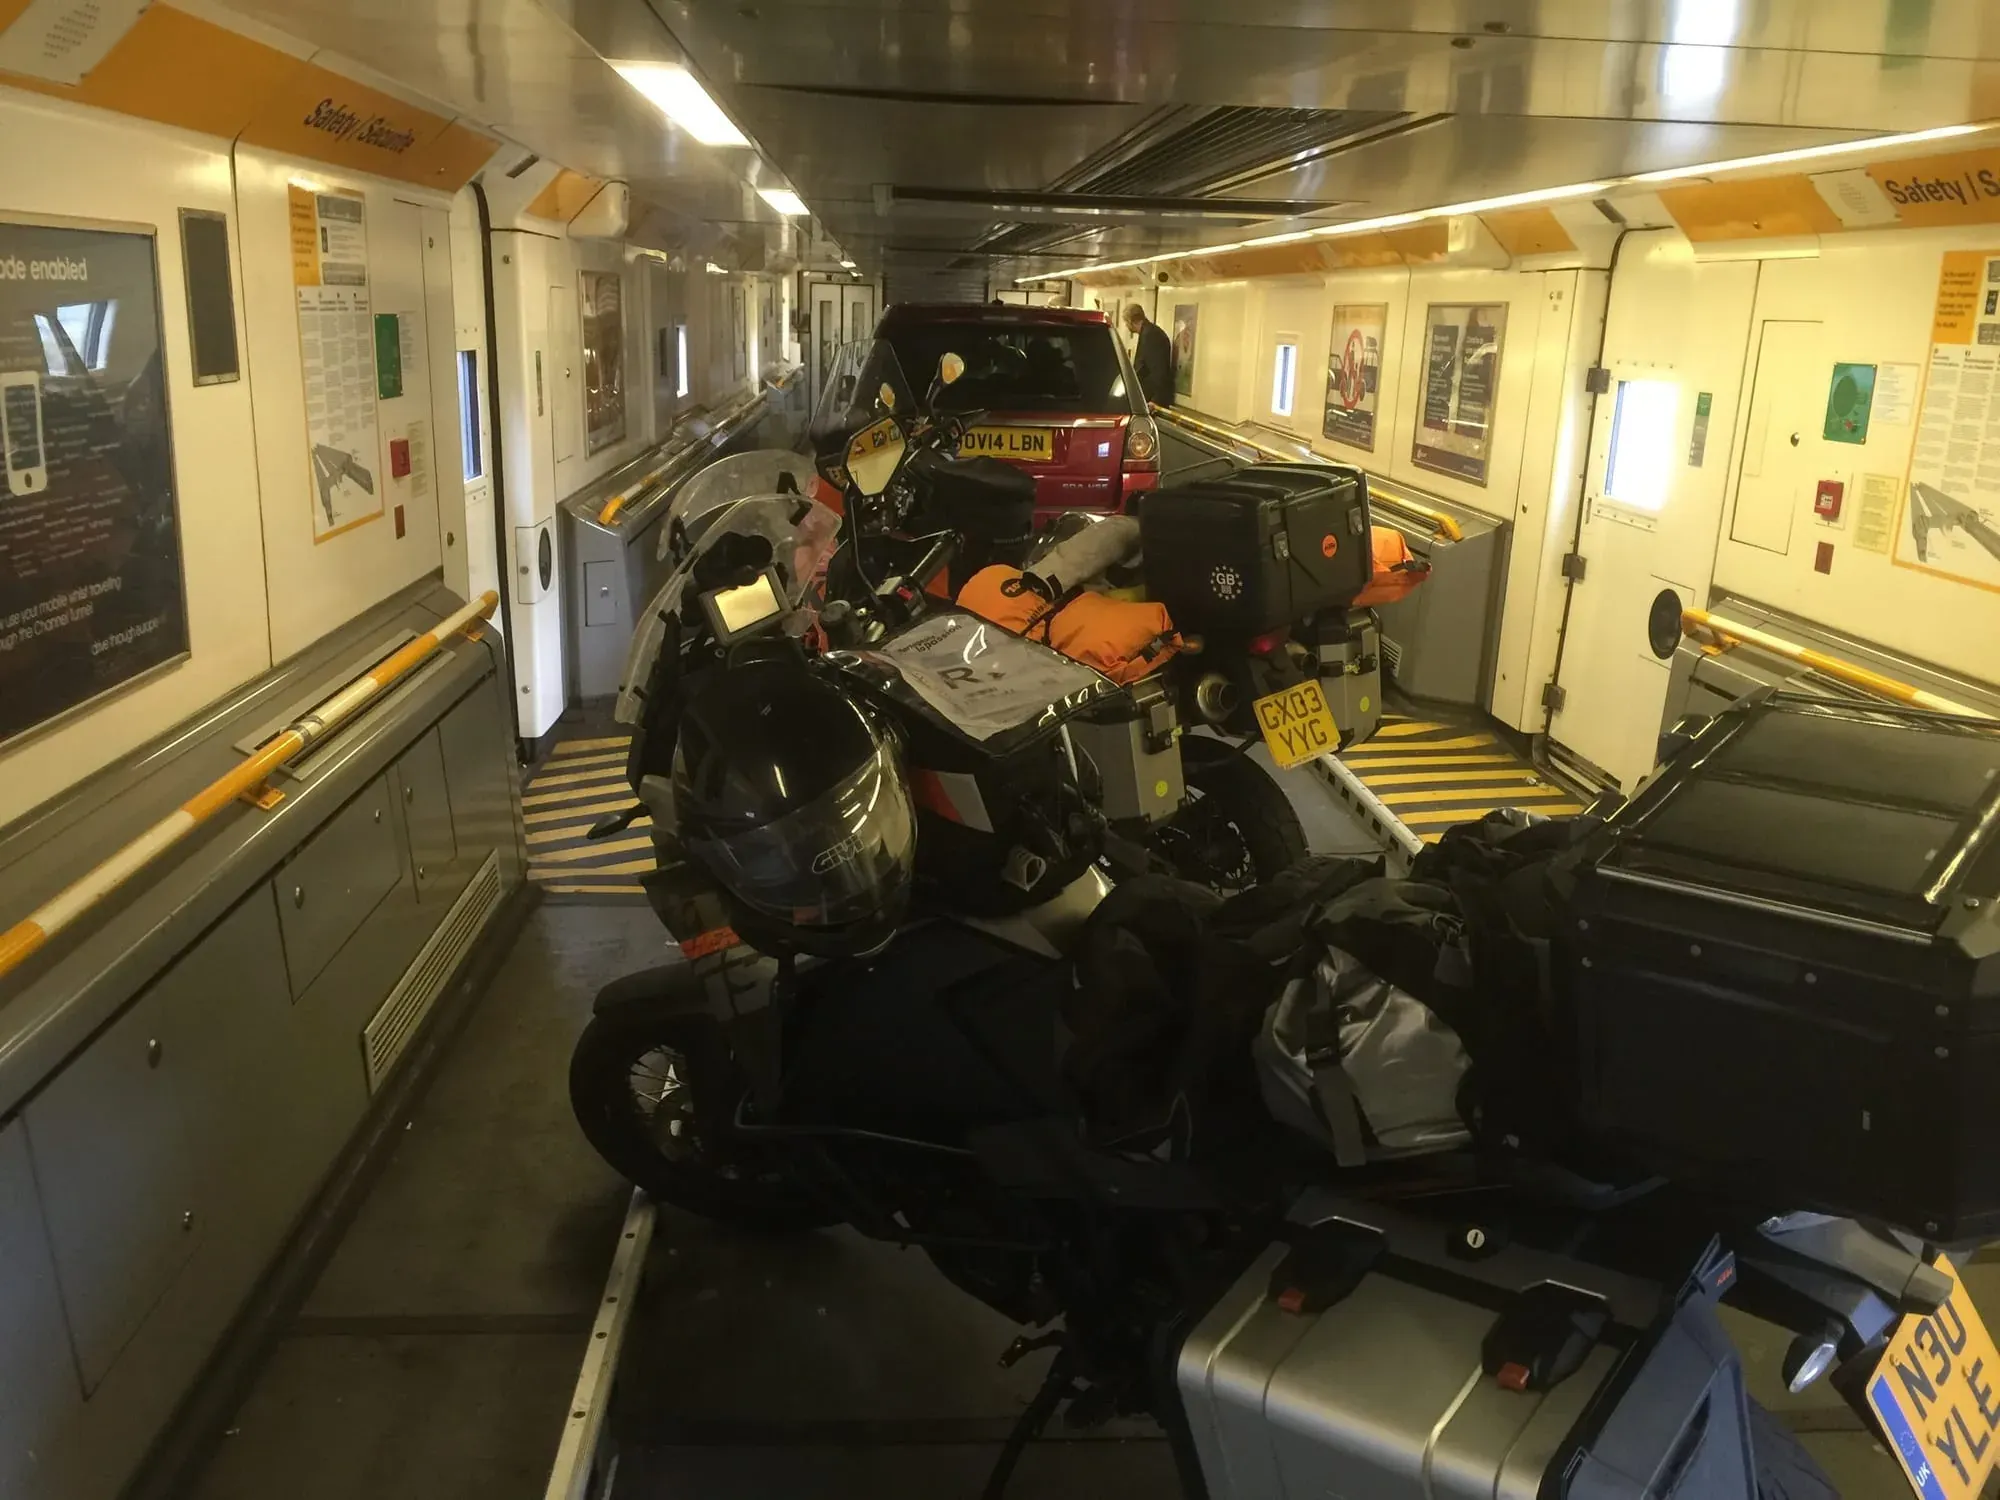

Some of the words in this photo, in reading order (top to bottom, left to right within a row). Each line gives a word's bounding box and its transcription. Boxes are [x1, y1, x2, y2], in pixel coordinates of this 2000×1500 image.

[303, 97, 361, 142] Safety
[1885, 175, 1968, 206] Safety
[964, 433, 1005, 450] OV14
[1009, 434, 1045, 452] LBN
[1216, 572, 1235, 586] GB
[1259, 686, 1323, 730] GX03
[1278, 718, 1328, 757] YYG
[1895, 1298, 1967, 1422] N3U
[1935, 1356, 2000, 1487] YLE
[1916, 1462, 1931, 1488] UK
